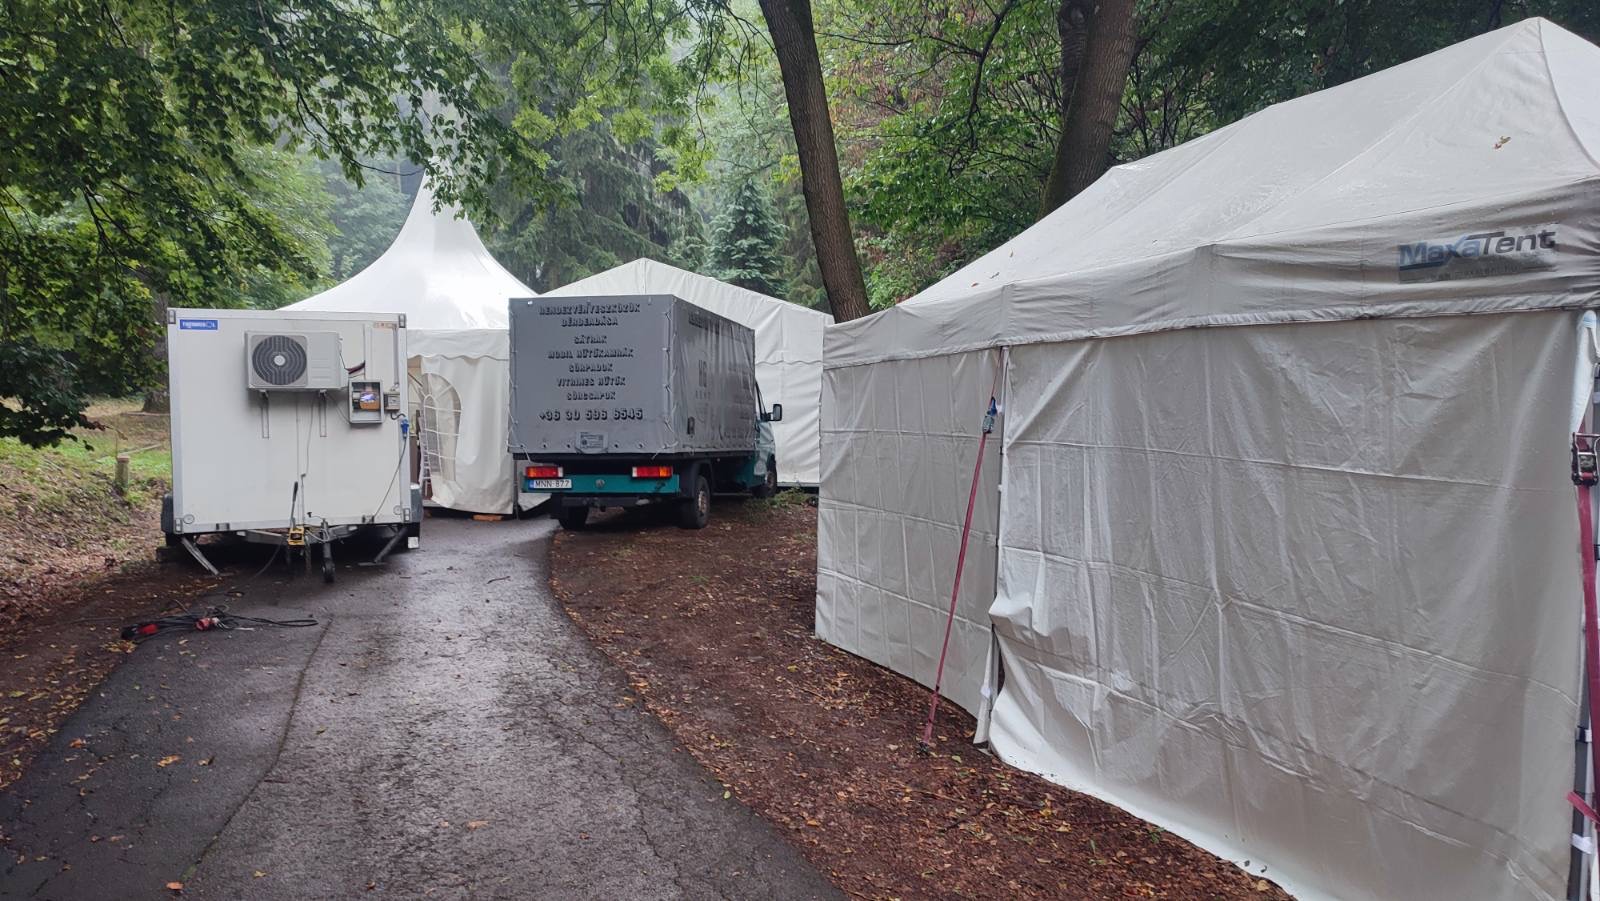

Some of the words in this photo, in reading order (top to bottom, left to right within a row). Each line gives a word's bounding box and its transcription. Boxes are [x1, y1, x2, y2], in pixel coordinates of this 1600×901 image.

[1399, 230, 1556, 266] MaxaTent
[539, 407, 561, 421] +36
[565, 407, 581, 421] 30
[535, 480, 570, 488] MNN-877
